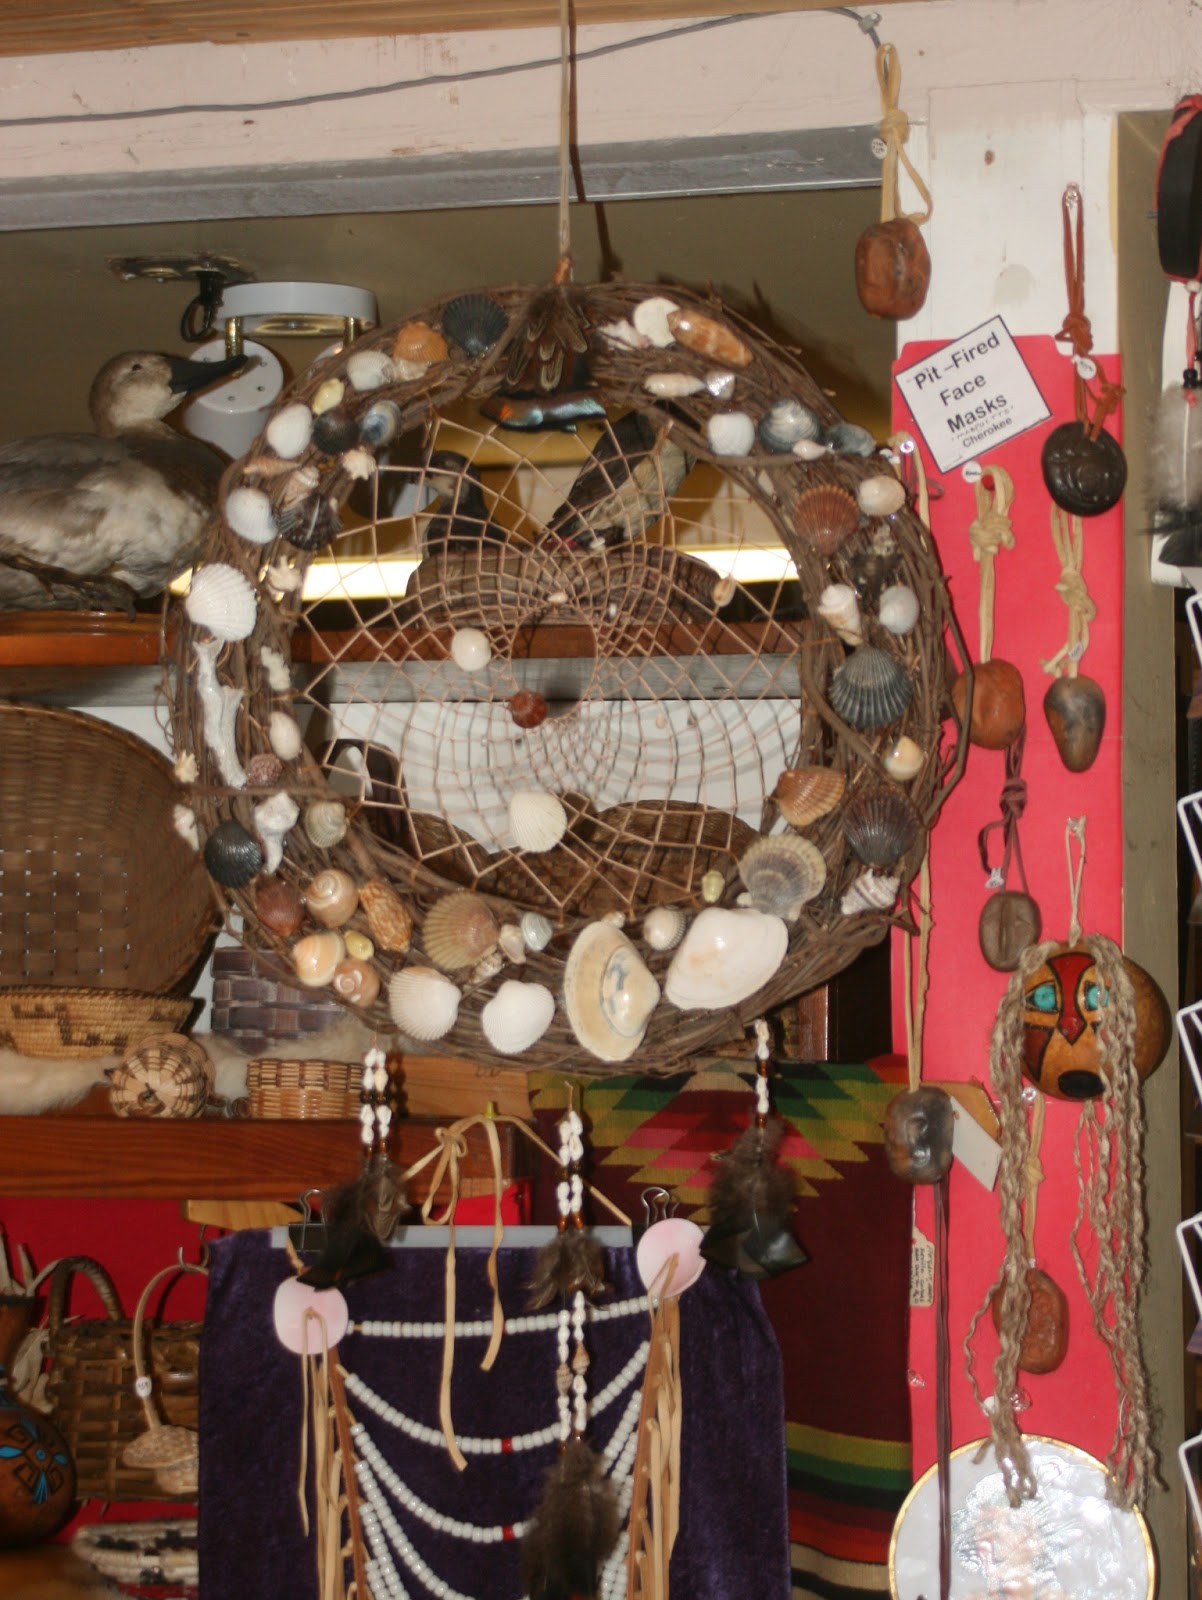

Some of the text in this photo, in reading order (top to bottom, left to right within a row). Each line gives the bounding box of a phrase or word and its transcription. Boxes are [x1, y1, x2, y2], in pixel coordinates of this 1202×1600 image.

[914, 366, 942, 390] Pit
[939, 374, 986, 406] Face
[947, 394, 1008, 433] Masks
[962, 417, 1012, 448] Cherokee
